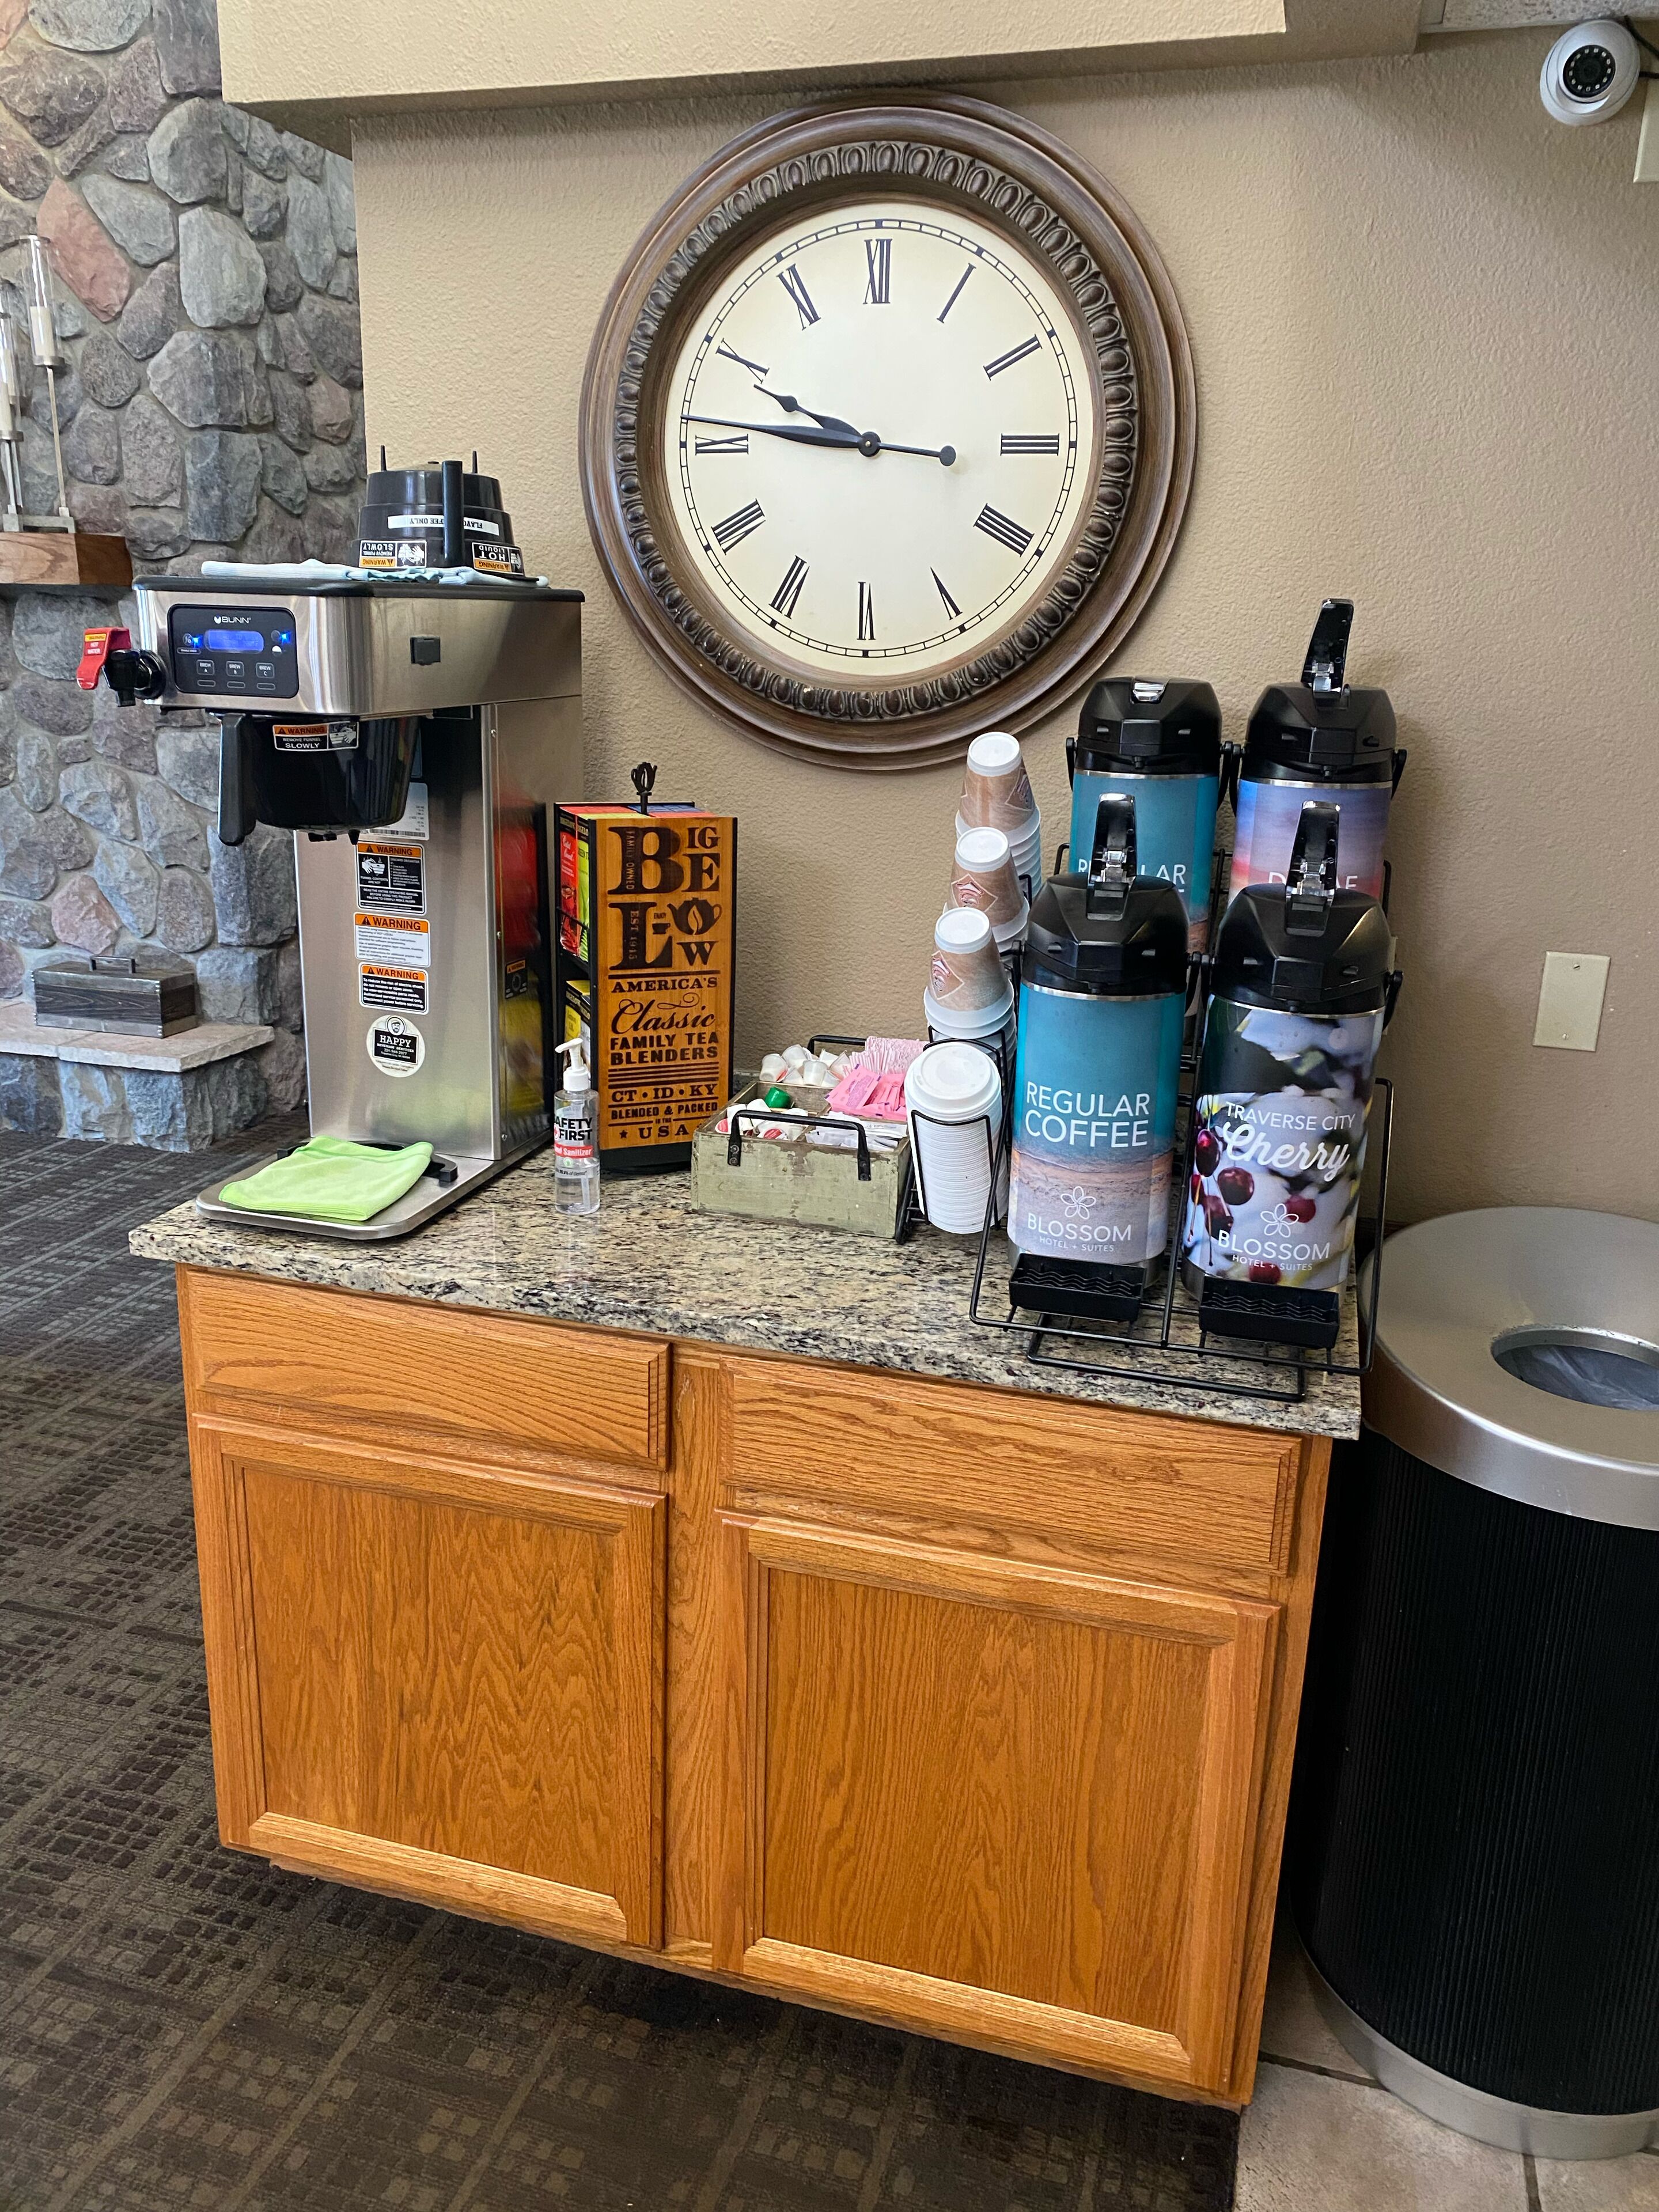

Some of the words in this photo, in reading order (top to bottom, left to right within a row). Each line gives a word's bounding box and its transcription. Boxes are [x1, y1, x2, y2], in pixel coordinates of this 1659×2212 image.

[863, 238, 892, 304] XII
[778, 263, 821, 331] XI
[715, 338, 770, 383] X
[983, 334, 1042, 381] II
[1000, 433, 1060, 456] III
[479, 544, 505, 552] LIQUID
[479, 551, 506, 560] HOT
[478, 560, 505, 569] WARNING
[768, 555, 810, 619] VII
[930, 566, 963, 621] V
[221, 616, 249, 624] BUNN
[857, 581, 876, 641] VI
[377, 846, 413, 855] WARNING
[626, 862, 635, 890] OWNED
[1078, 858, 1187, 884] RLAR
[373, 916, 421, 931] WARNING
[630, 910, 639, 931] EST
[376, 967, 419, 980] WARNING
[611, 977, 718, 993] AMERICA'S
[611, 999, 715, 1035] Classic
[380, 1035, 411, 1048] HAPPY
[610, 1033, 676, 1050] FAMILY
[685, 1032, 719, 1046] TEA
[610, 1046, 718, 1066] BLENDERS
[611, 1089, 637, 1103] CT
[653, 1087, 674, 1100] ID
[689, 1084, 718, 1097] KY
[1026, 1081, 1150, 1118] REGULAR
[611, 1105, 660, 1120] BLENDED
[664, 1105, 673, 1115] &
[677, 1102, 718, 1114] PACKED
[1225, 1101, 1318, 1131] TRAVERSE
[1321, 1113, 1356, 1131] CITY
[555, 1116, 593, 1130] AFETY
[1025, 1109, 1149, 1148] COFFEE
[559, 1128, 593, 1141] FIRST
[563, 1147, 592, 1157] Sanitizer
[1218, 1120, 1350, 1182] Cherry
[1027, 1211, 1132, 1243] BLOSSOM
[1039, 1236, 1069, 1249] HOTEL
[1081, 1243, 1115, 1252] SUITES
[1218, 1229, 1330, 1261] BLOSSOM
[1232, 1254, 1266, 1268] HOTEL
[1279, 1263, 1313, 1271] SUITES
